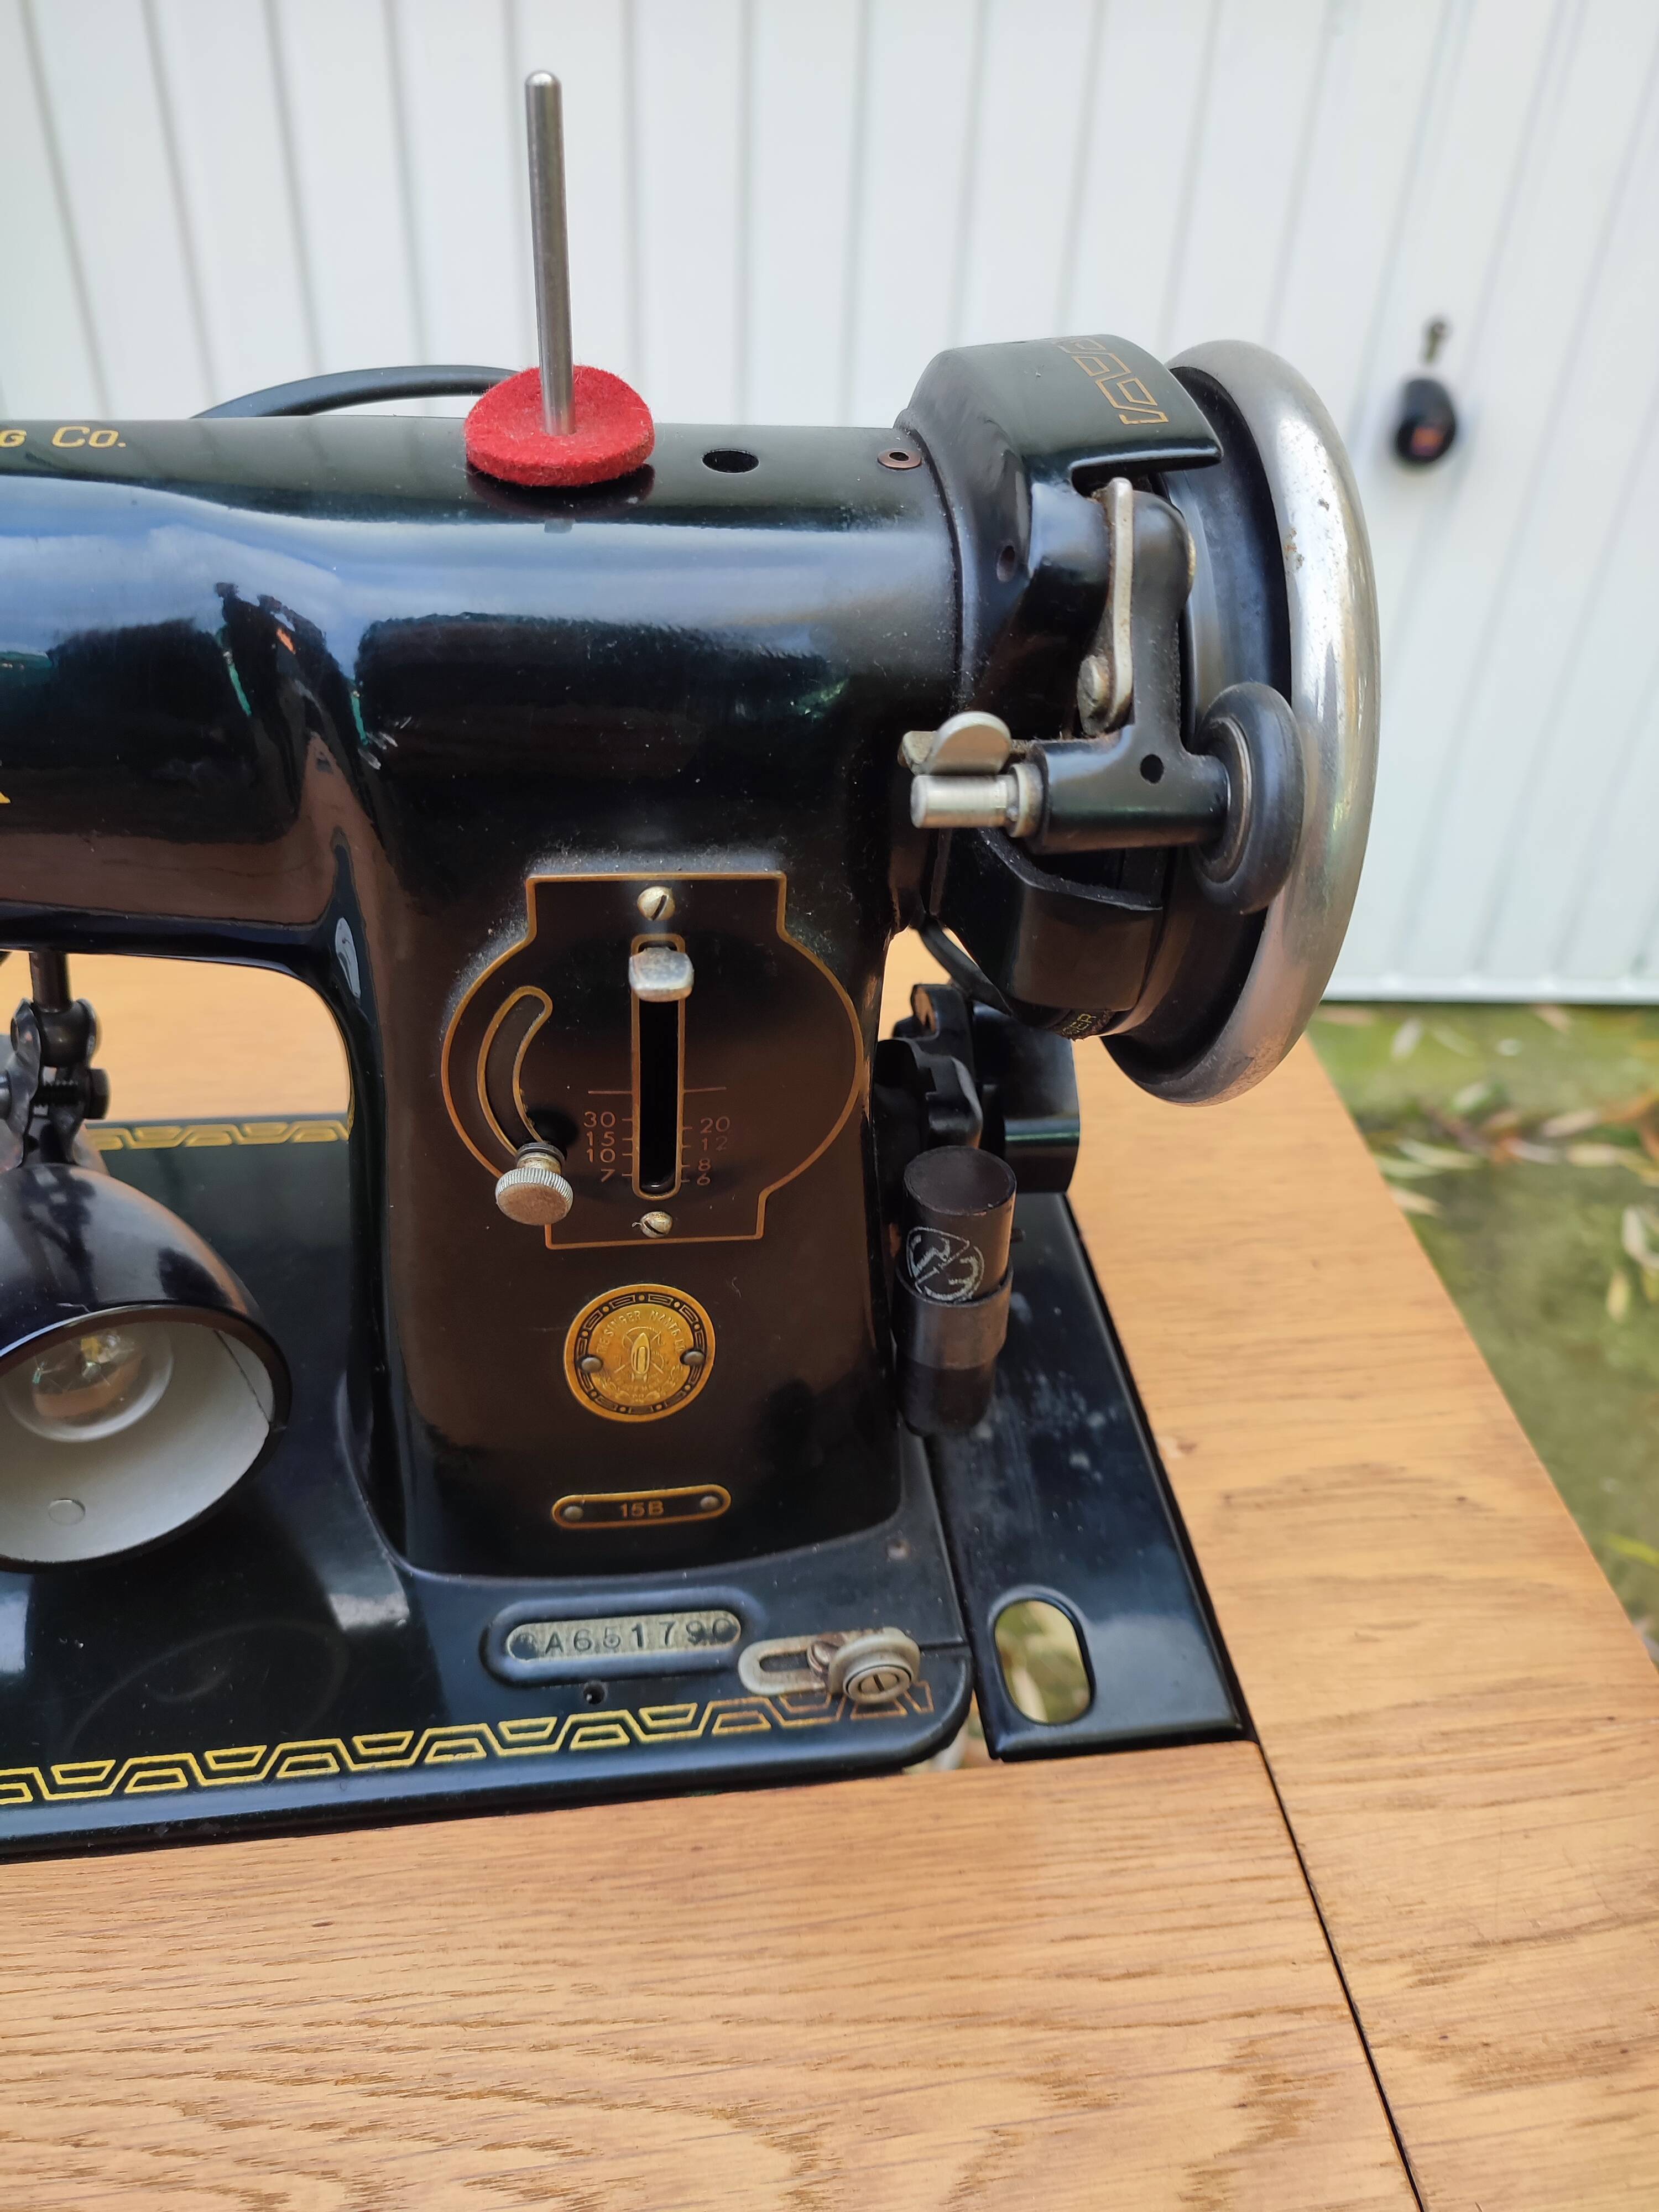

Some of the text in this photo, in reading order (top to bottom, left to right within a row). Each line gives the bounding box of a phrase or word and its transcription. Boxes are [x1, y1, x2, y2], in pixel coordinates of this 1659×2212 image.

[584, 1112, 615, 1128] 30
[700, 1116, 731, 1134] 20
[587, 1132, 615, 1146] 15
[702, 1136, 728, 1151] 12
[587, 1148, 615, 1162] 10
[698, 1159, 711, 1171] 8
[601, 1169, 615, 1182] 7
[697, 1173, 711, 1186] 6
[604, 1310, 641, 1337] SINGER
[620, 1500, 664, 1517] 15B
